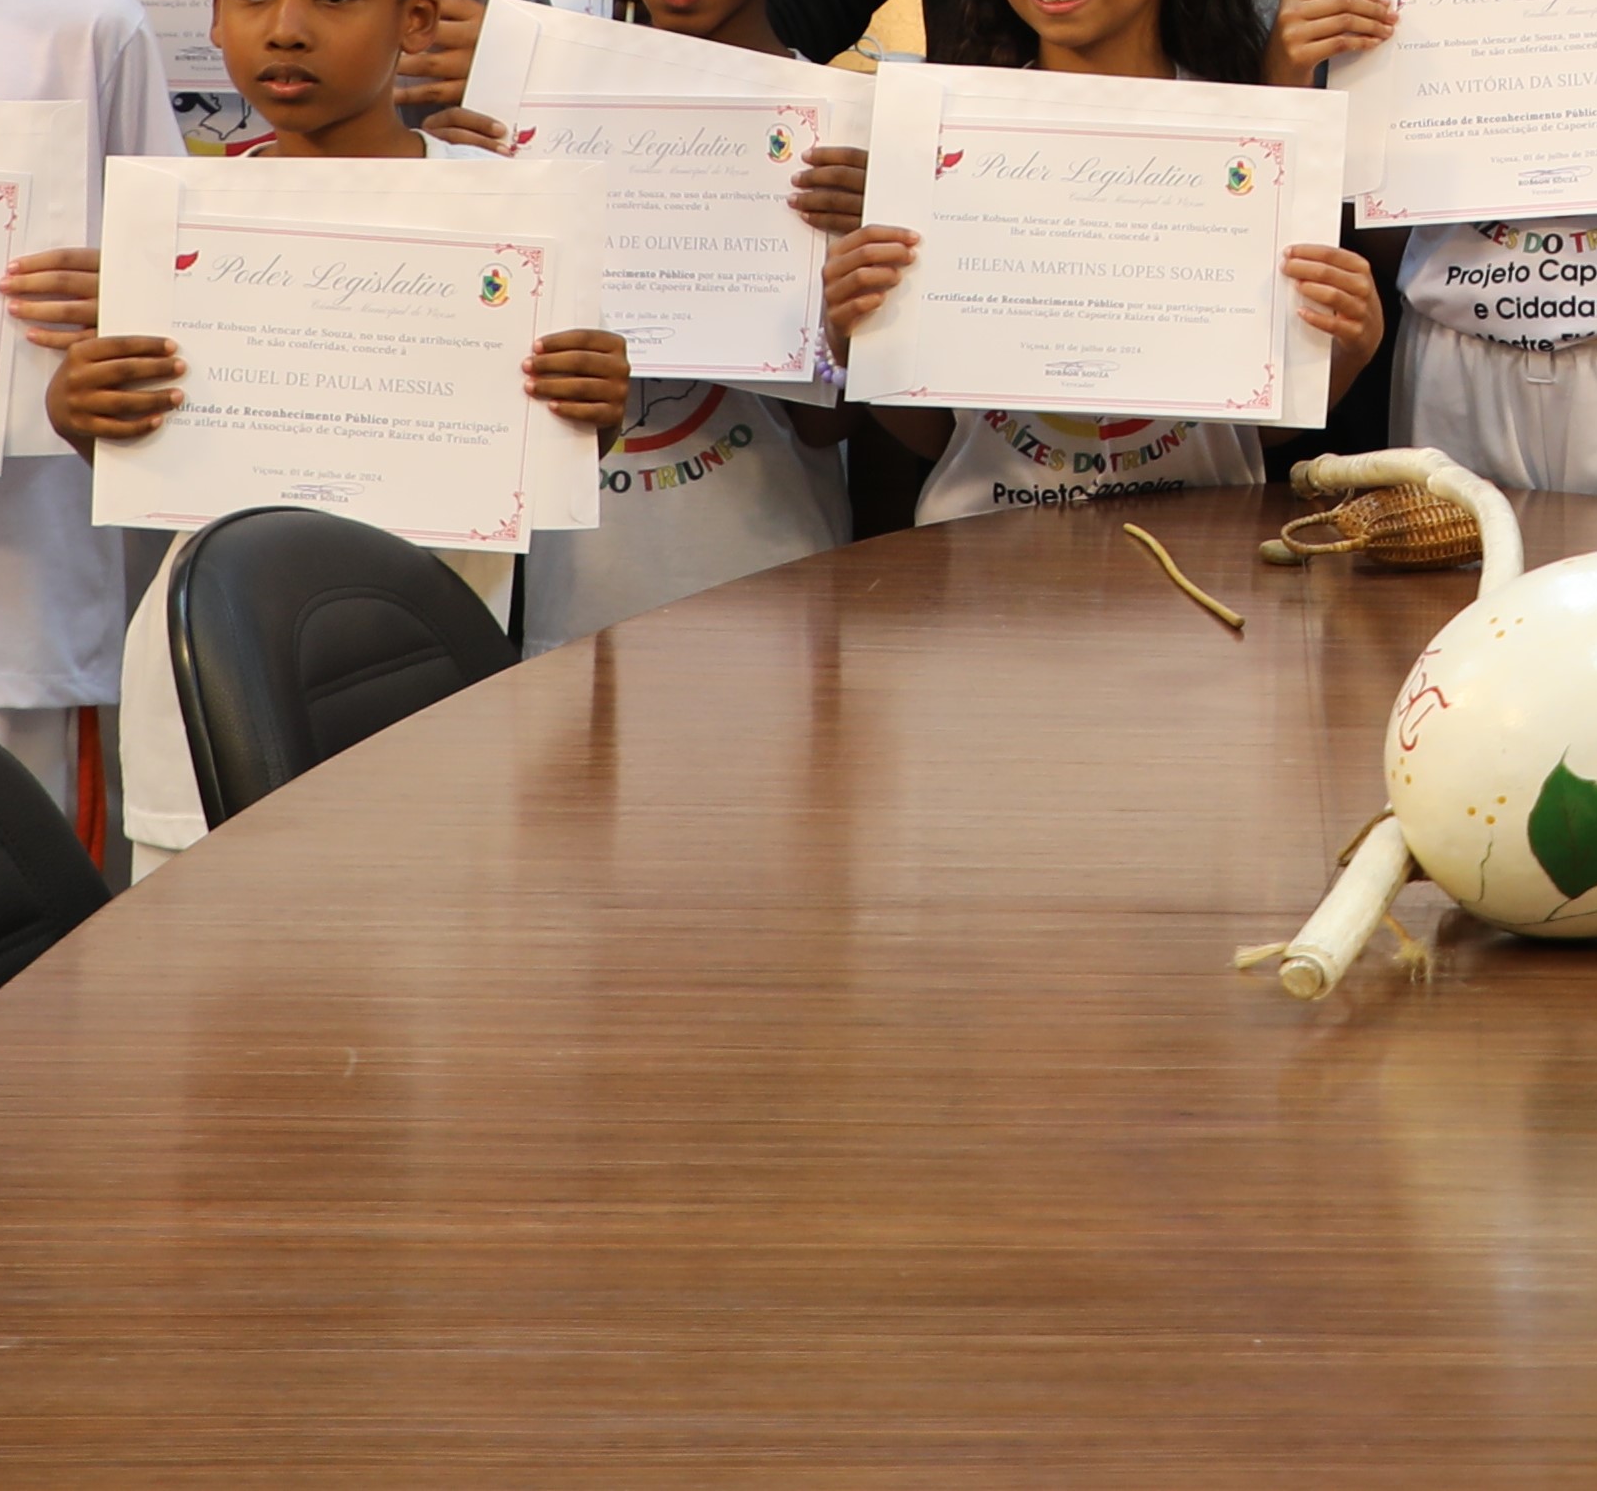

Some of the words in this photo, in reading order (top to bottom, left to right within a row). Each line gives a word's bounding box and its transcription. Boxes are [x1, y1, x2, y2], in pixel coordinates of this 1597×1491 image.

[1417, 82, 1451, 97] ANA
[1455, 75, 1525, 93] VITÓRIA
[1530, 75, 1553, 89] DA
[619, 235, 640, 249] DE
[645, 236, 718, 251] OLIVEIRA
[723, 237, 789, 252] BATISTA
[1523, 232, 1563, 254] DO
[207, 254, 296, 288] Poder
[305, 263, 456, 305] Legislativo
[958, 257, 1025, 273] HELENA
[1031, 260, 1107, 276] MARTINS
[1112, 264, 1165, 279] LOPES
[1170, 267, 1234, 282] SOARES
[1445, 263, 1530, 287] Projeto
[1474, 303, 1488, 319] e
[208, 367, 279, 385] MIGUEL
[286, 372, 309, 387] DE
[315, 373, 372, 391] PAULA
[378, 378, 454, 396] MESSIAS
[985, 410, 1066, 471] RAÍZES
[638, 423, 754, 494] TRIUNFO
